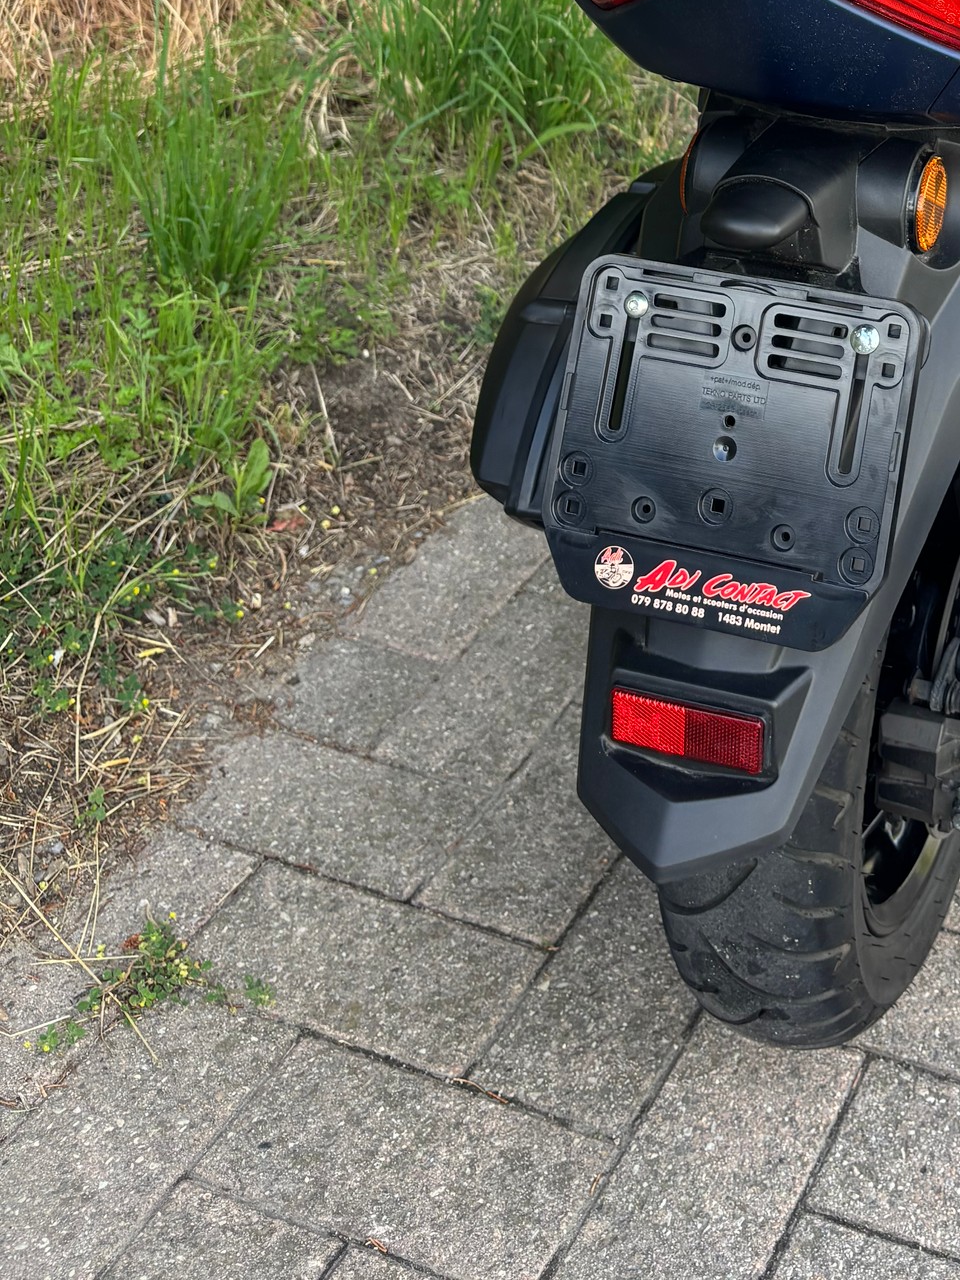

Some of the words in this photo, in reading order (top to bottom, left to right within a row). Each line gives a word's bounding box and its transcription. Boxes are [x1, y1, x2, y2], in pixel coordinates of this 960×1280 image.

[665, 588, 691, 602] Motos
[693, 594, 702, 604] et
[703, 597, 738, 612] scooters
[739, 603, 784, 621] d'occasion
[702, 573, 812, 611] CONTACT
[631, 594, 651, 607] 079
[653, 598, 673, 612] 878
[675, 603, 689, 616] 80
[691, 606, 705, 619] 88
[717, 611, 742, 627] 1483
[744, 618, 781, 635] Montet
